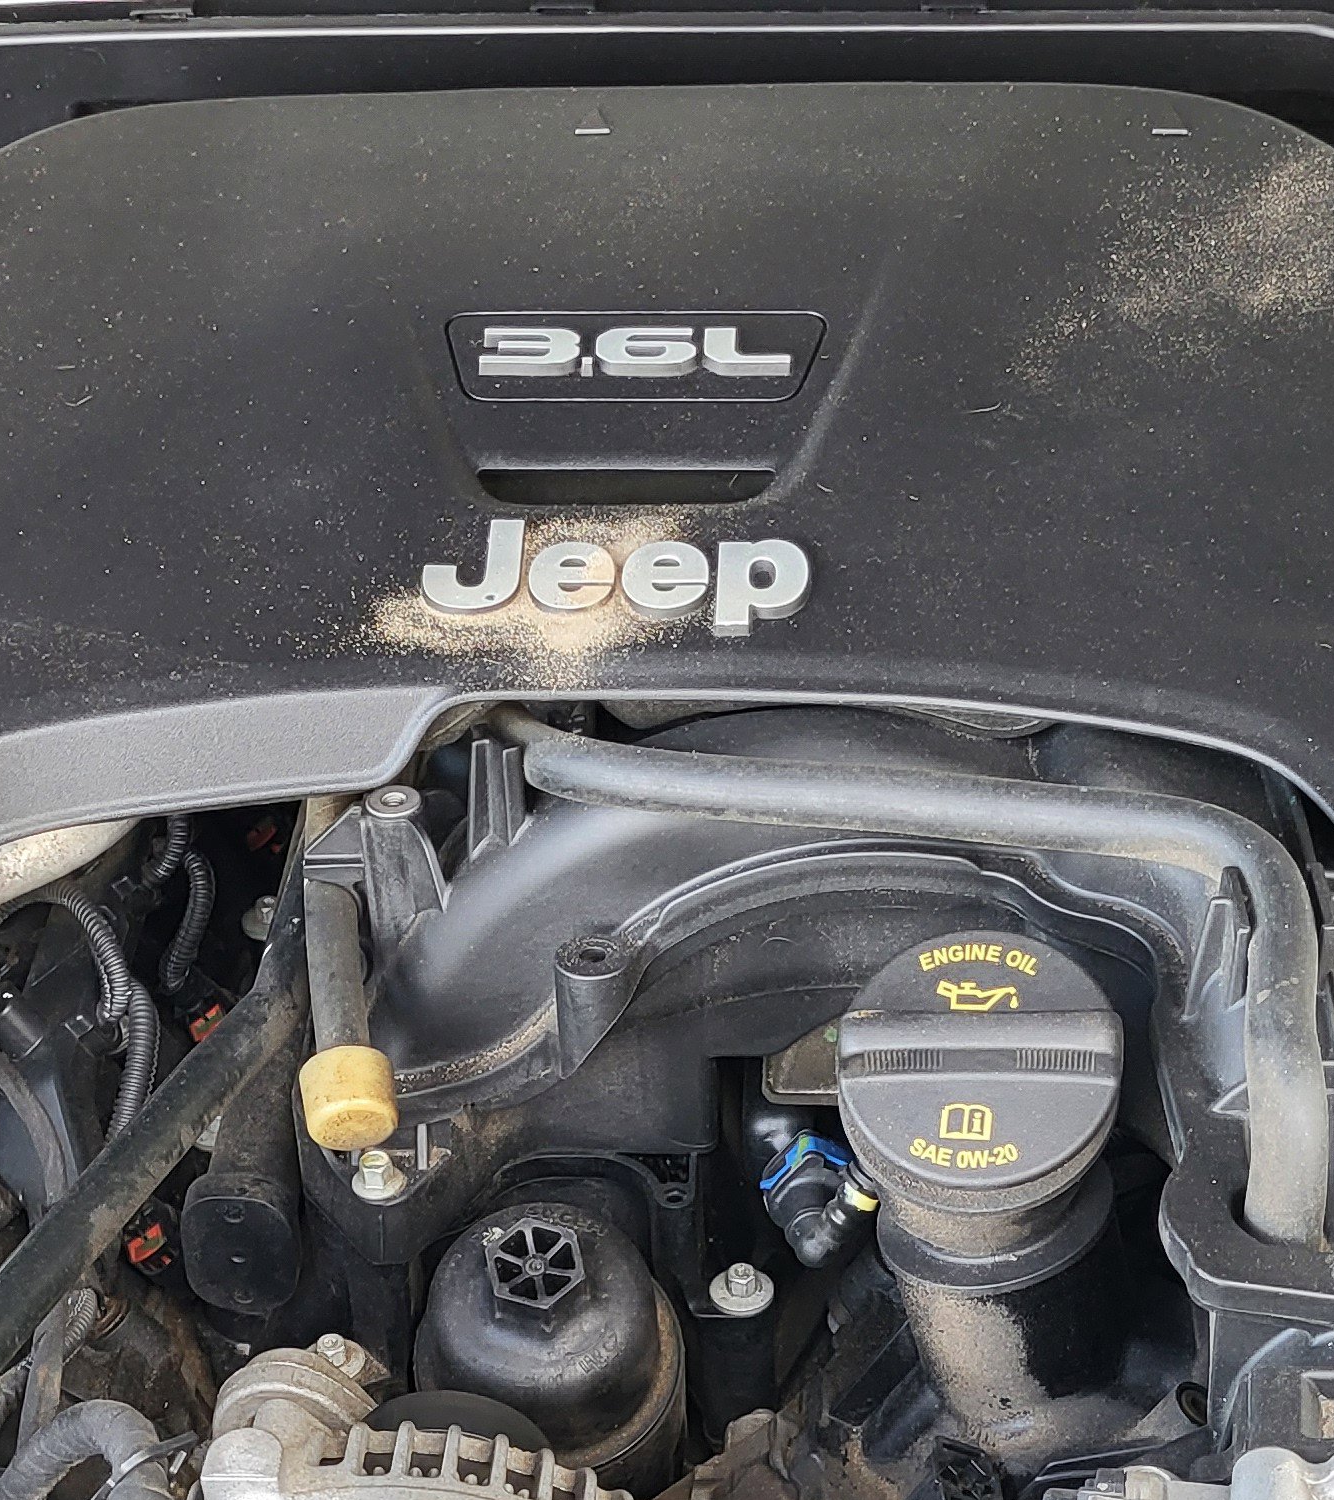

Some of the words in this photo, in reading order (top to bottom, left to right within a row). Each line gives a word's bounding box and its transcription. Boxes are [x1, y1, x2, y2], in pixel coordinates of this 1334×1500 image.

[477, 327, 792, 378] 3.6L
[421, 519, 813, 638] Jeep
[918, 943, 1002, 973] ENGINE
[1004, 945, 1040, 976] OIL
[909, 1138, 952, 1167] SAE
[956, 1143, 1019, 1171] 0W-20
